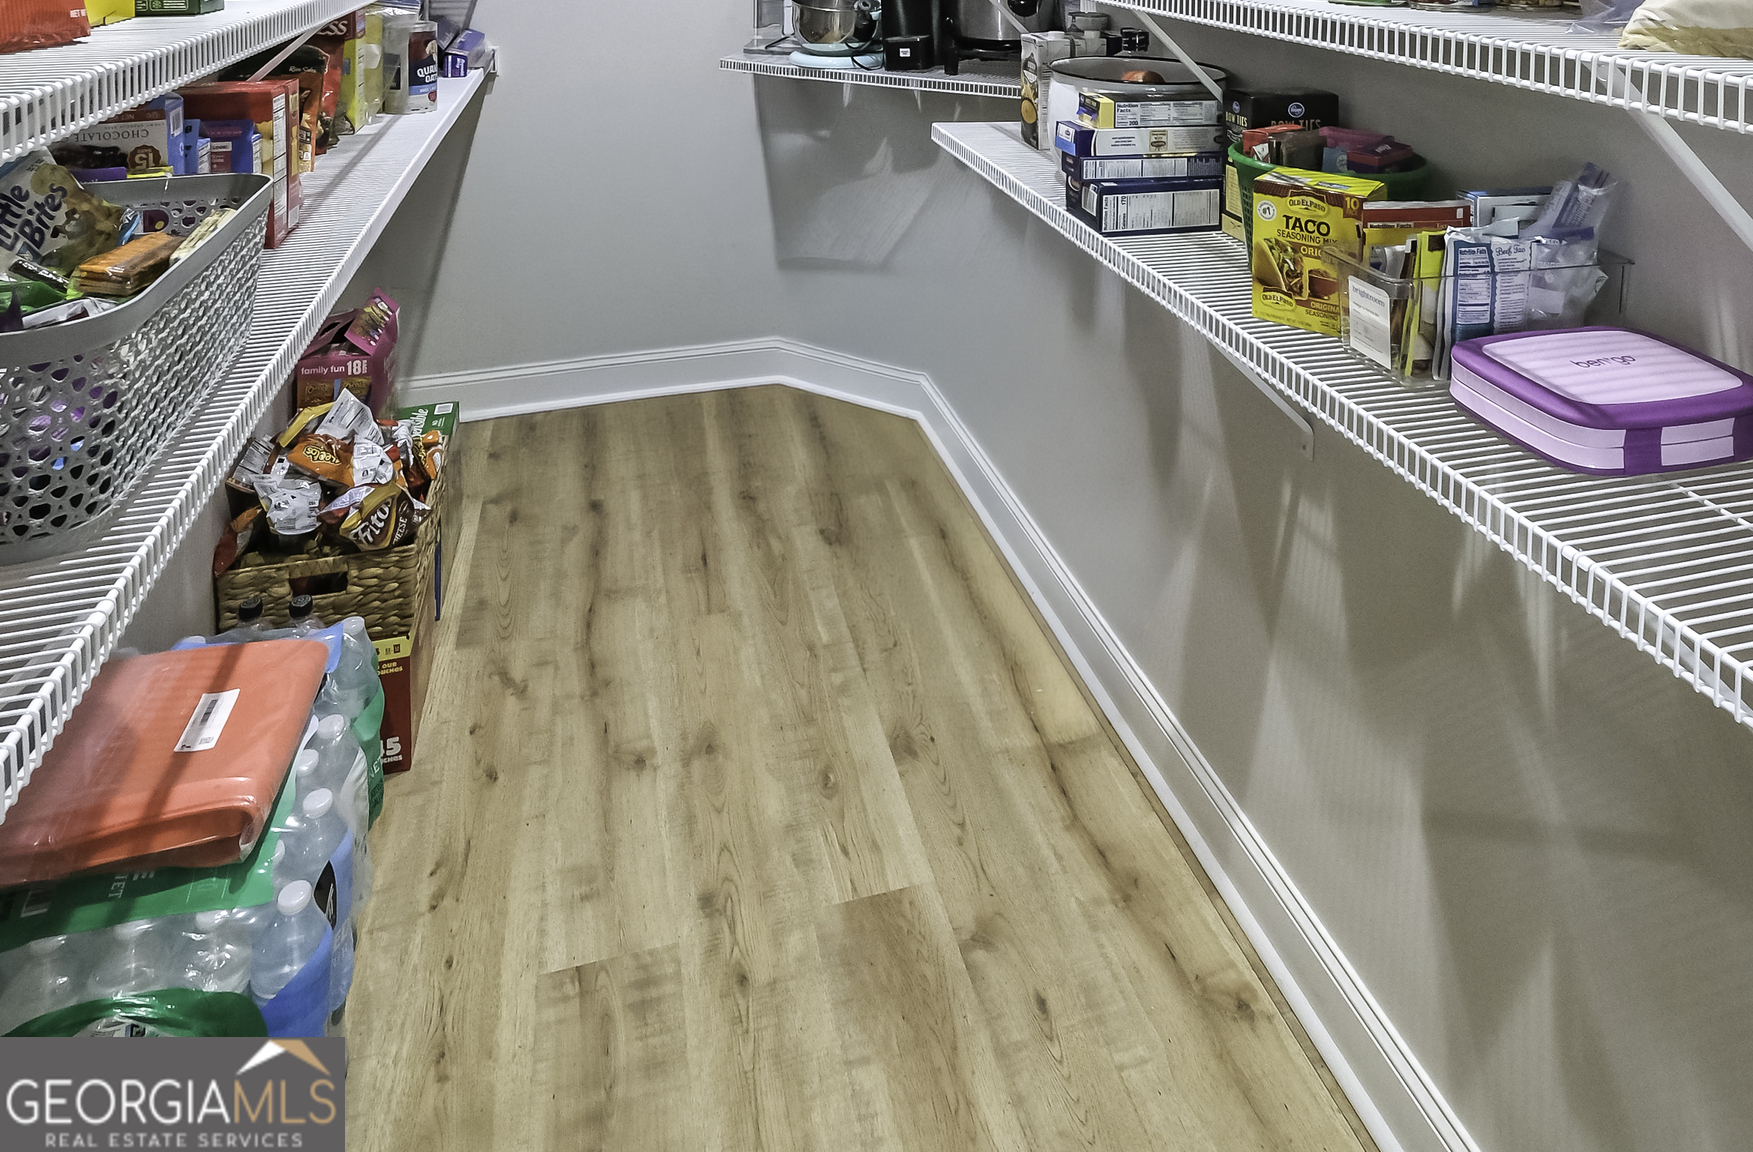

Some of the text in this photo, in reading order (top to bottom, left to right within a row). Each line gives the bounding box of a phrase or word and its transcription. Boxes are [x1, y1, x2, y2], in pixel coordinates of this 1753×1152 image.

[75, 128, 149, 143] CHOCOLATE
[135, 152, 155, 166] 15
[1262, 205, 1271, 215] #1
[1288, 198, 1302, 207] OLD
[1344, 196, 1360, 209] 10
[1282, 214, 1331, 237] TACO
[1276, 228, 1322, 245] SEASONING
[1261, 293, 1273, 301] OLD
[1351, 284, 1386, 308] brightroom
[301, 359, 362, 376] family fun 18
[352, 500, 390, 545] Fritos
